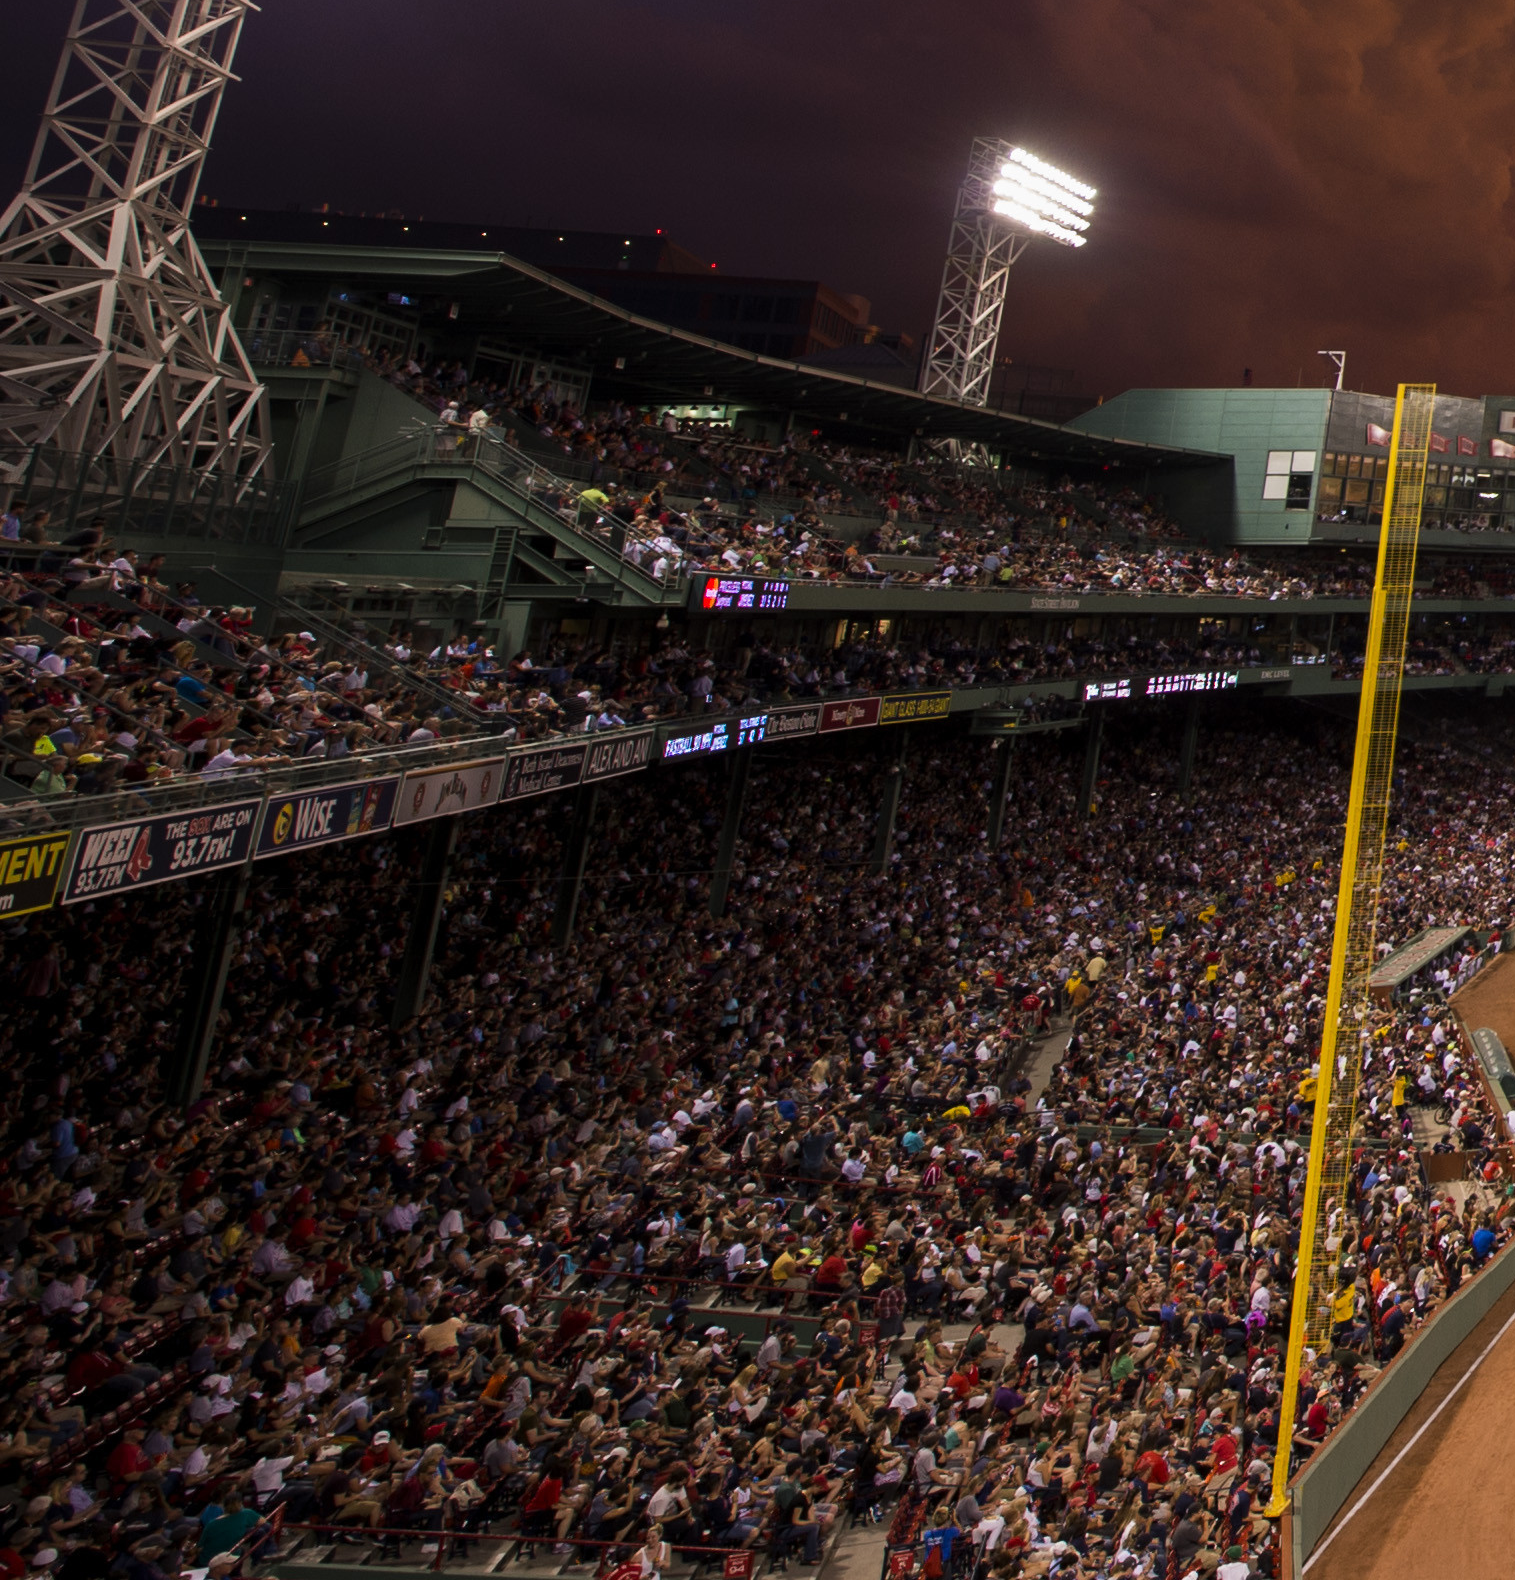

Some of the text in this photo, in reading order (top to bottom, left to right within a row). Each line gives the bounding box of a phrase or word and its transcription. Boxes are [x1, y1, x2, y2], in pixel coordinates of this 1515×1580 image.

[588, 744, 615, 774] ALEX
[612, 740, 634, 769] AND
[165, 808, 253, 841] THE SOX ARE ON
[80, 825, 141, 870] WEEI
[74, 864, 127, 895] 93.7FM
